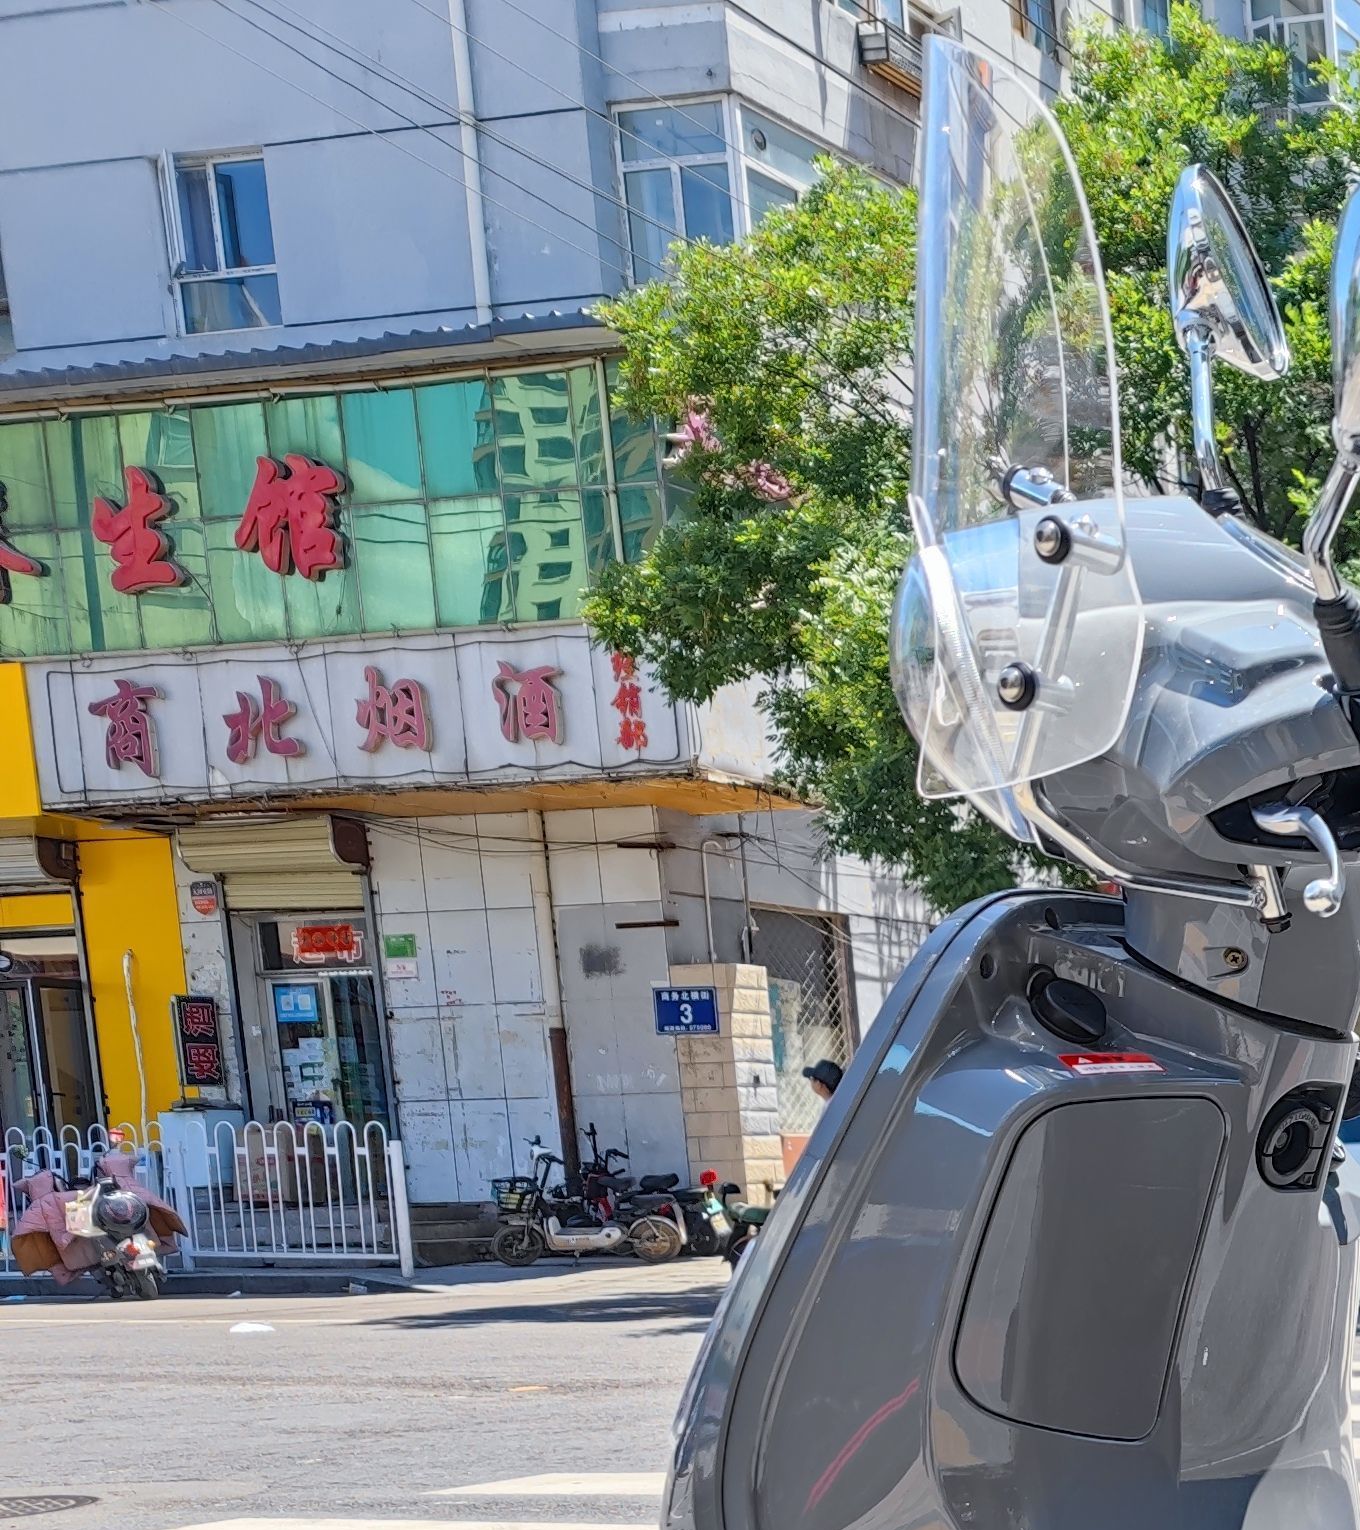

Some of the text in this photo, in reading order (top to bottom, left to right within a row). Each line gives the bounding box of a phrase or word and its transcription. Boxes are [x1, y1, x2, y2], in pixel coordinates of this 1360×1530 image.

[0, 453, 346, 602] 生馆
[88, 660, 566, 779] 商北烟酒
[679, 1003, 693, 1024] 3
